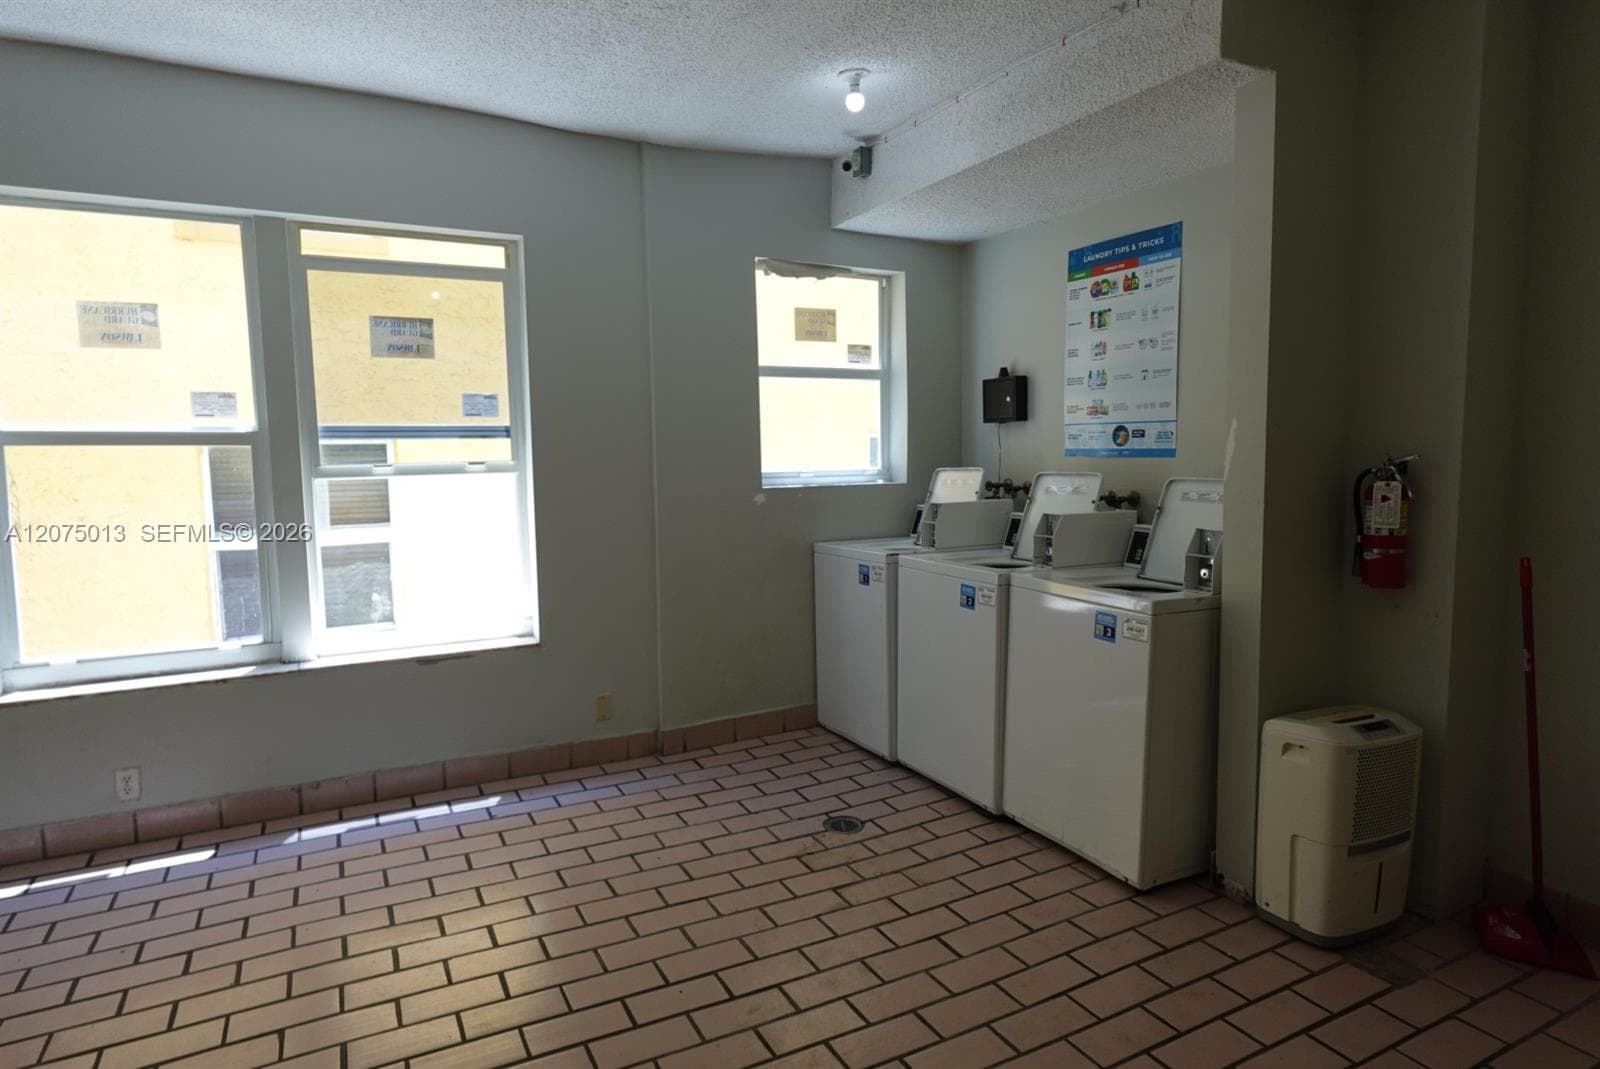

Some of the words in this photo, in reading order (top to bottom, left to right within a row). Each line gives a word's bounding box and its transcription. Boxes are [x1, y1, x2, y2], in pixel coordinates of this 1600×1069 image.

[1083, 250, 1113, 263] LAUNDRY
[1114, 244, 1130, 255] TIPS
[1131, 243, 1137, 251] &
[1138, 236, 1165, 249] TRICKS
